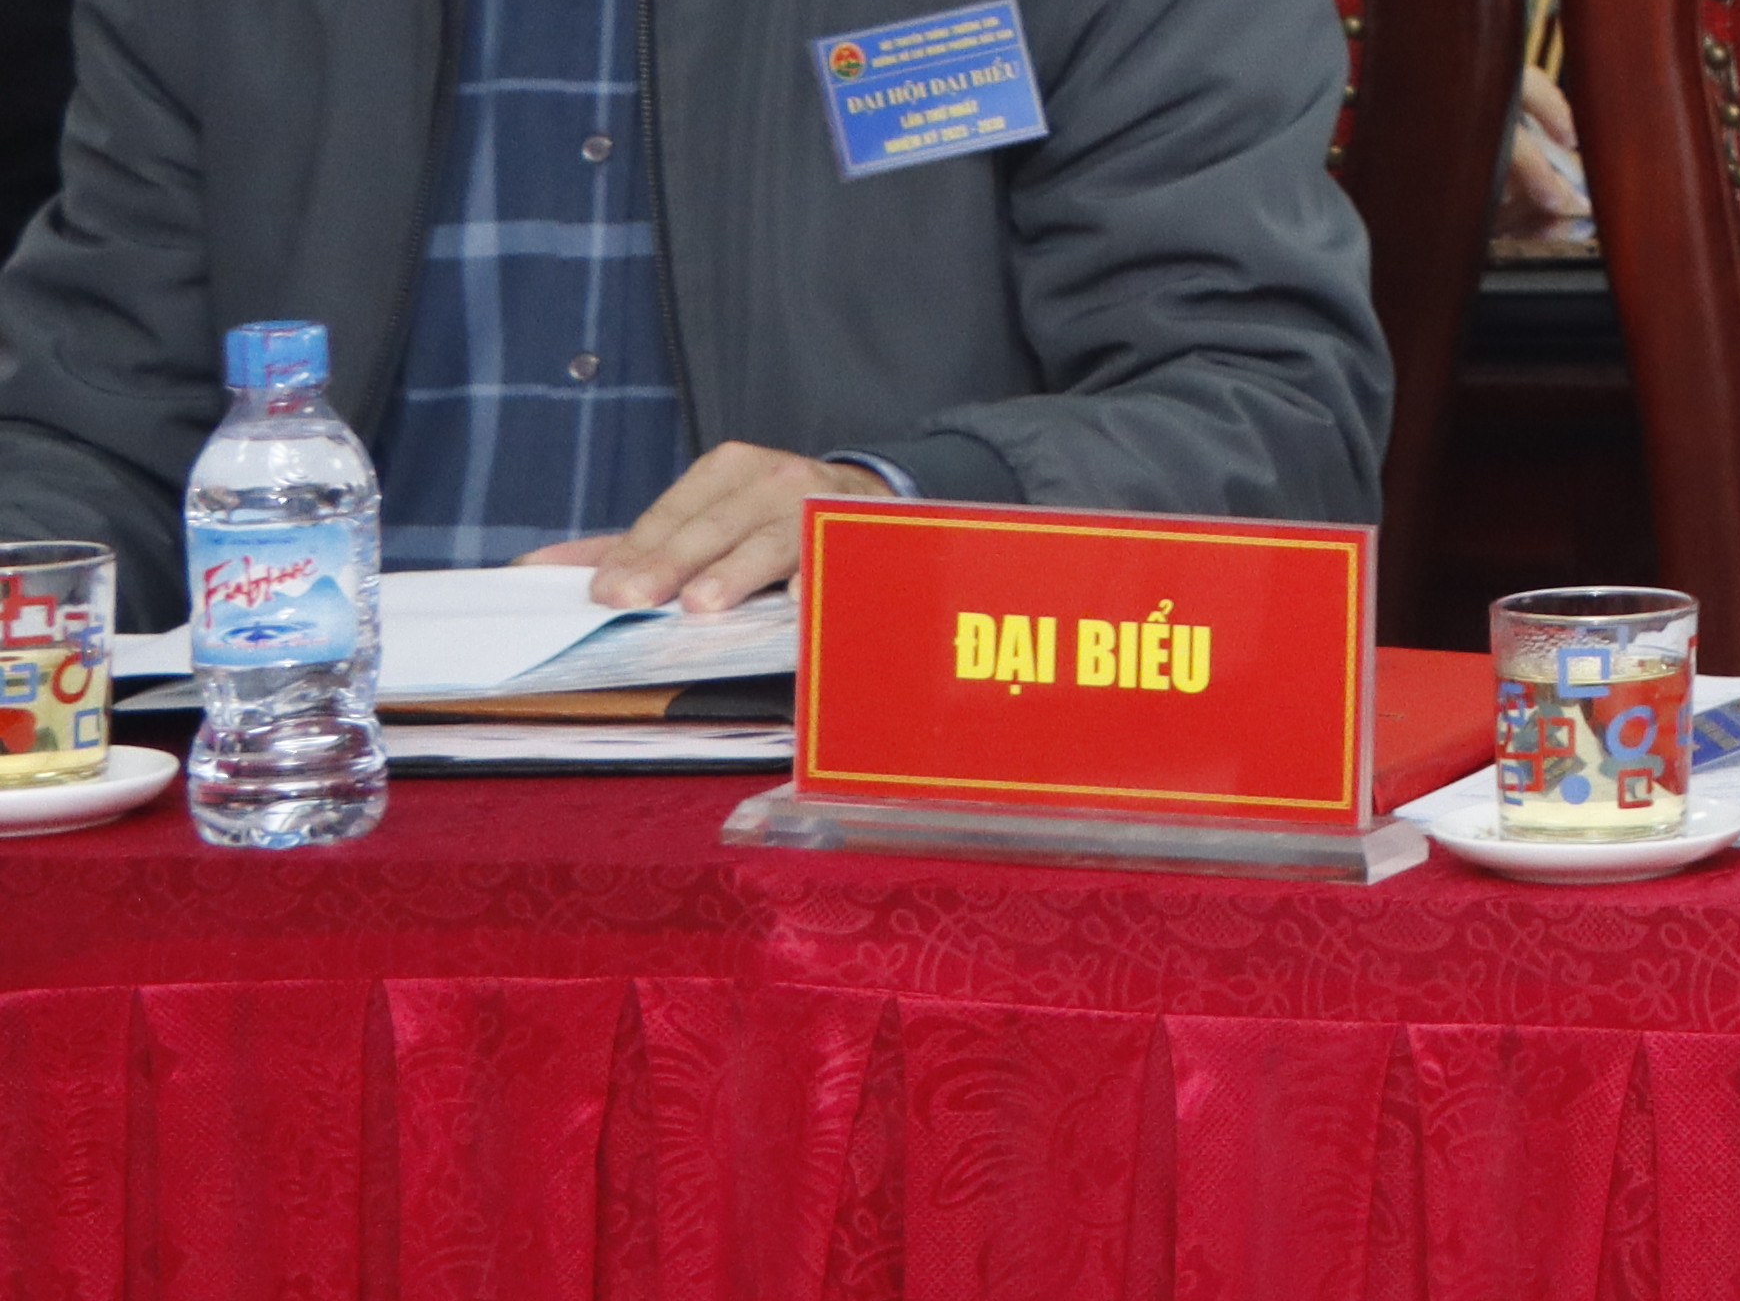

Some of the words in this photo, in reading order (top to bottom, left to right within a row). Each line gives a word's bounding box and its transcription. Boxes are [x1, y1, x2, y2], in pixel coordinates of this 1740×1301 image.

[847, 91, 884, 113] ĐẠI
[887, 81, 927, 104] HỘI
[930, 72, 968, 95] ĐẠI
[954, 611, 1056, 695] ĐẠI
[1076, 598, 1211, 694] BIỂU
